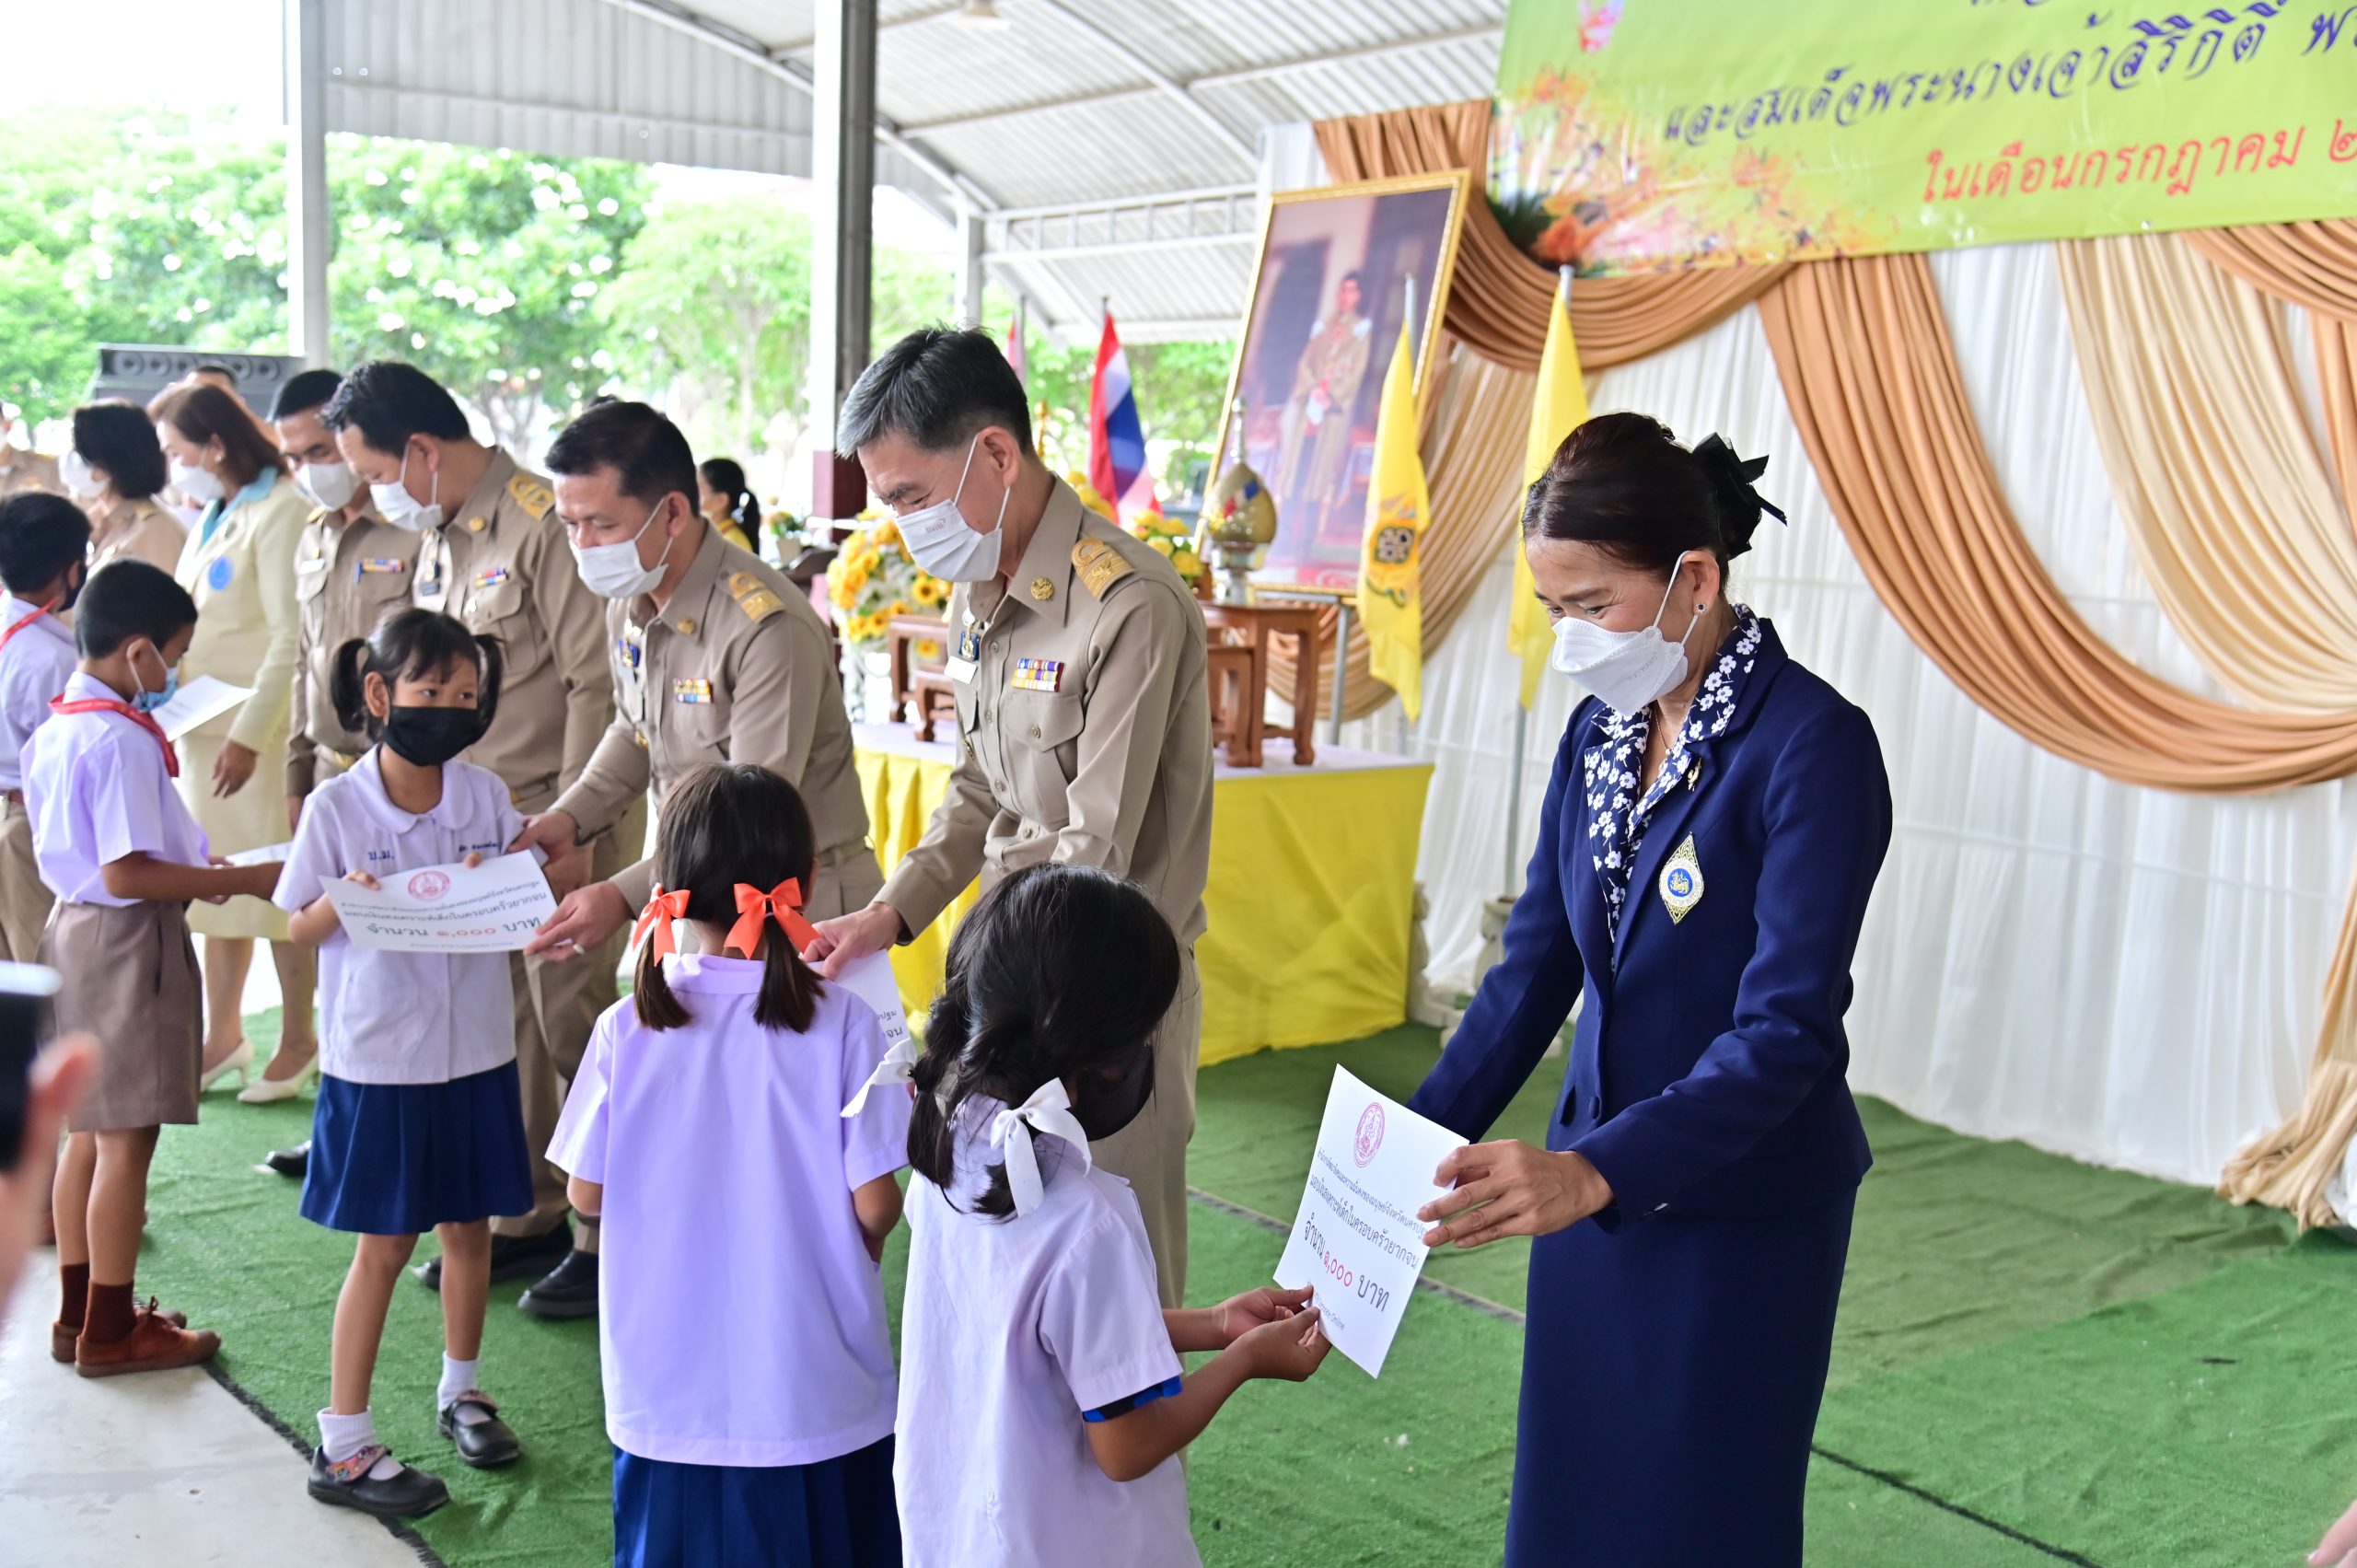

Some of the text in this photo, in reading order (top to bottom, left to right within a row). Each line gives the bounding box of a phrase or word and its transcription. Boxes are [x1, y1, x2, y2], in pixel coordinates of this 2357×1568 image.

[2302, 6, 2357, 55] พ
[1923, 125, 2305, 203] ในเดือนกรกฎาคม
[503, 916, 541, 933] บาท
[1304, 1212, 1325, 1260] จำนวน
[1357, 1274, 1389, 1311] บาท
